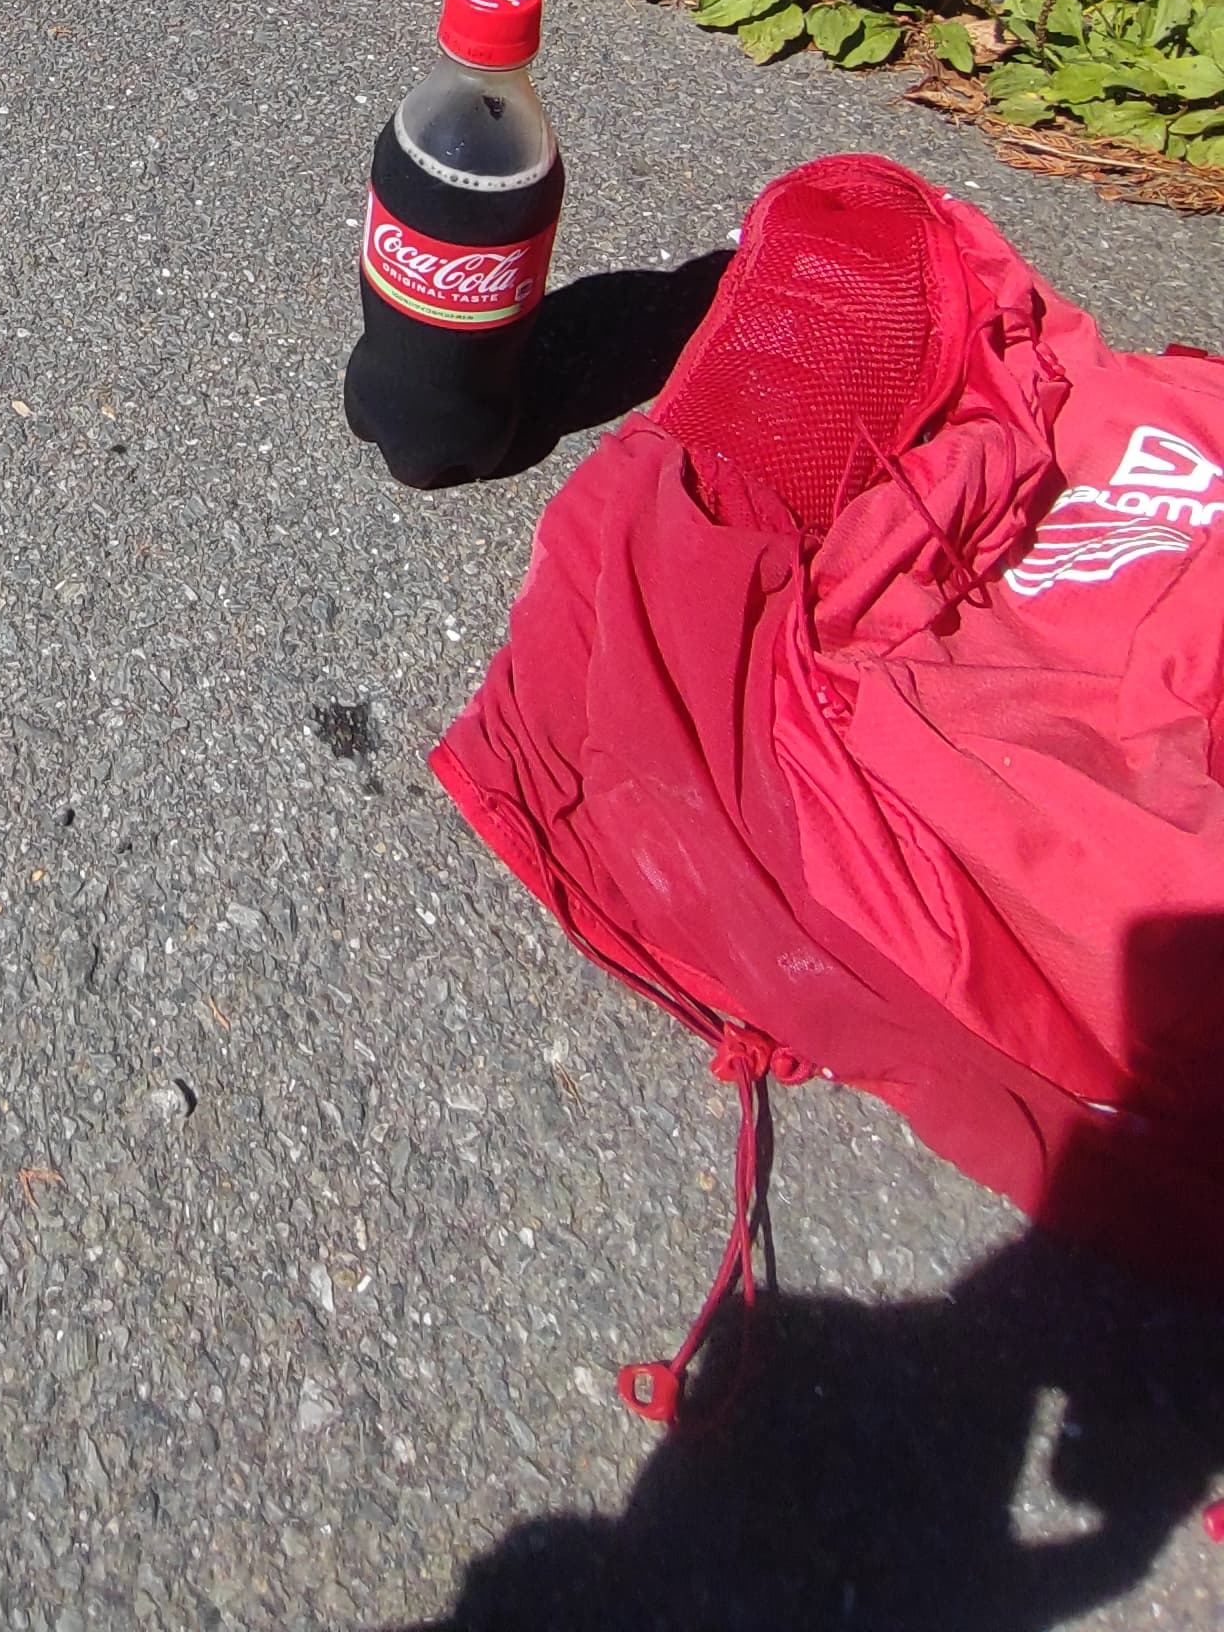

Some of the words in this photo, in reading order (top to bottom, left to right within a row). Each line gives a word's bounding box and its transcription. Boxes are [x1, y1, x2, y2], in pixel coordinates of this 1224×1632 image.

[374, 224, 531, 294] Coca-Cola
[382, 262, 446, 300] ORIGINAL
[451, 292, 500, 304] TASTE
